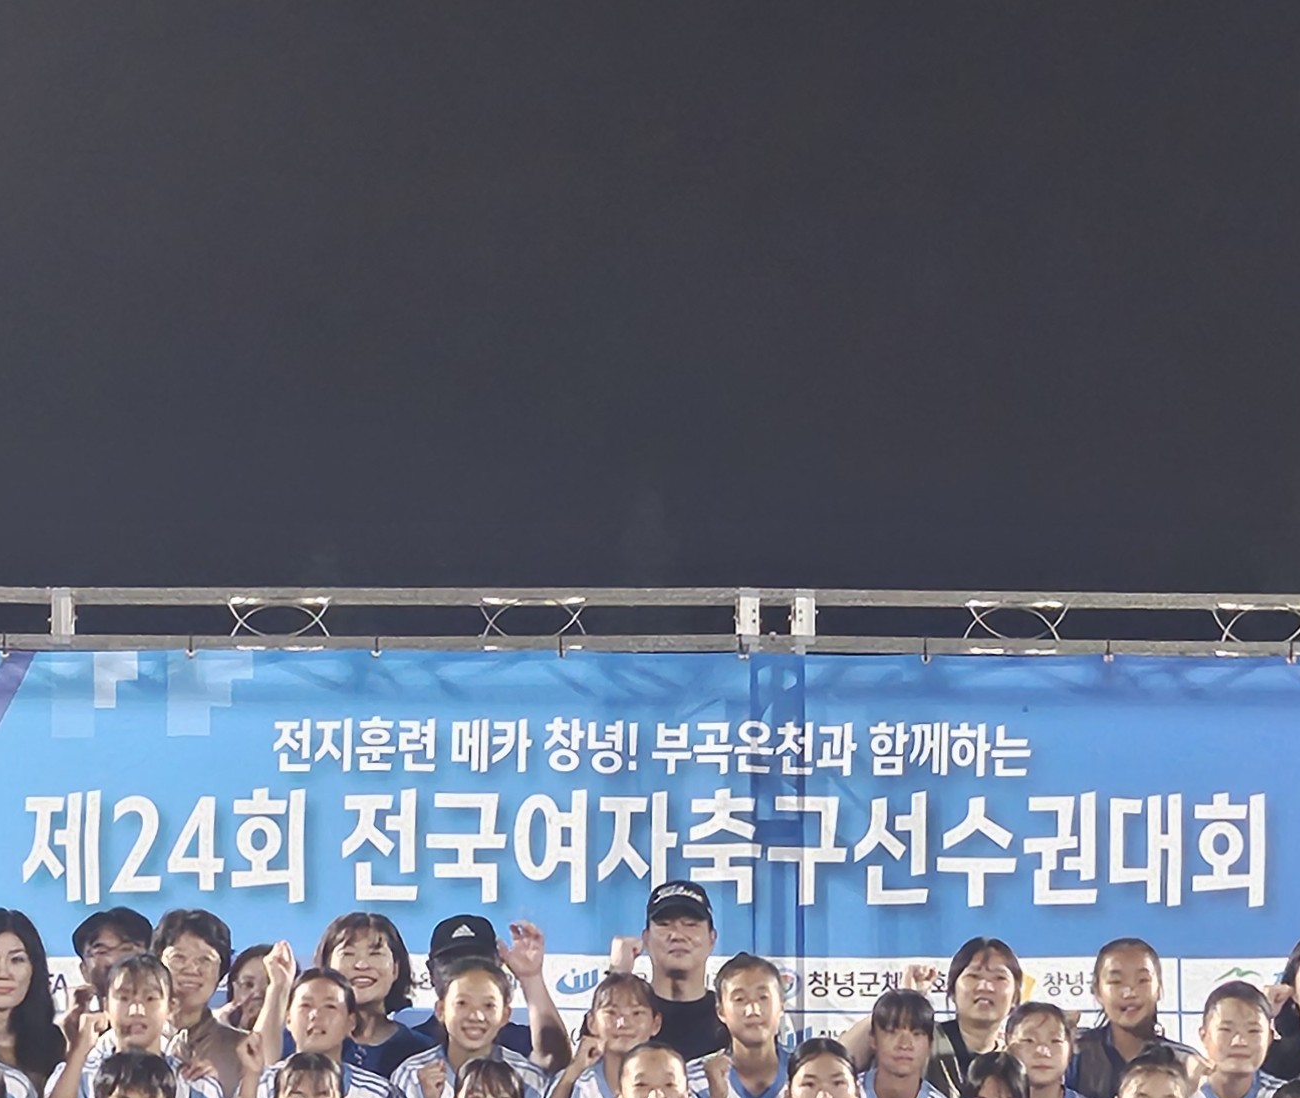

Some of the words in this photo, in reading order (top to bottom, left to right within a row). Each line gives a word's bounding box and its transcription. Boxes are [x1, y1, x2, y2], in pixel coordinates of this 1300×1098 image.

[273, 715, 435, 773] 전지훈련
[451, 719, 532, 772] 메카
[544, 715, 638, 775] 창녕!
[651, 717, 857, 777] 부곡온천과
[869, 720, 1032, 777] 함께하는
[22, 787, 305, 907] 제24회
[341, 788, 1267, 909] 전국여자축구선수권대회
[807, 970, 949, 998] 창녕군체회
